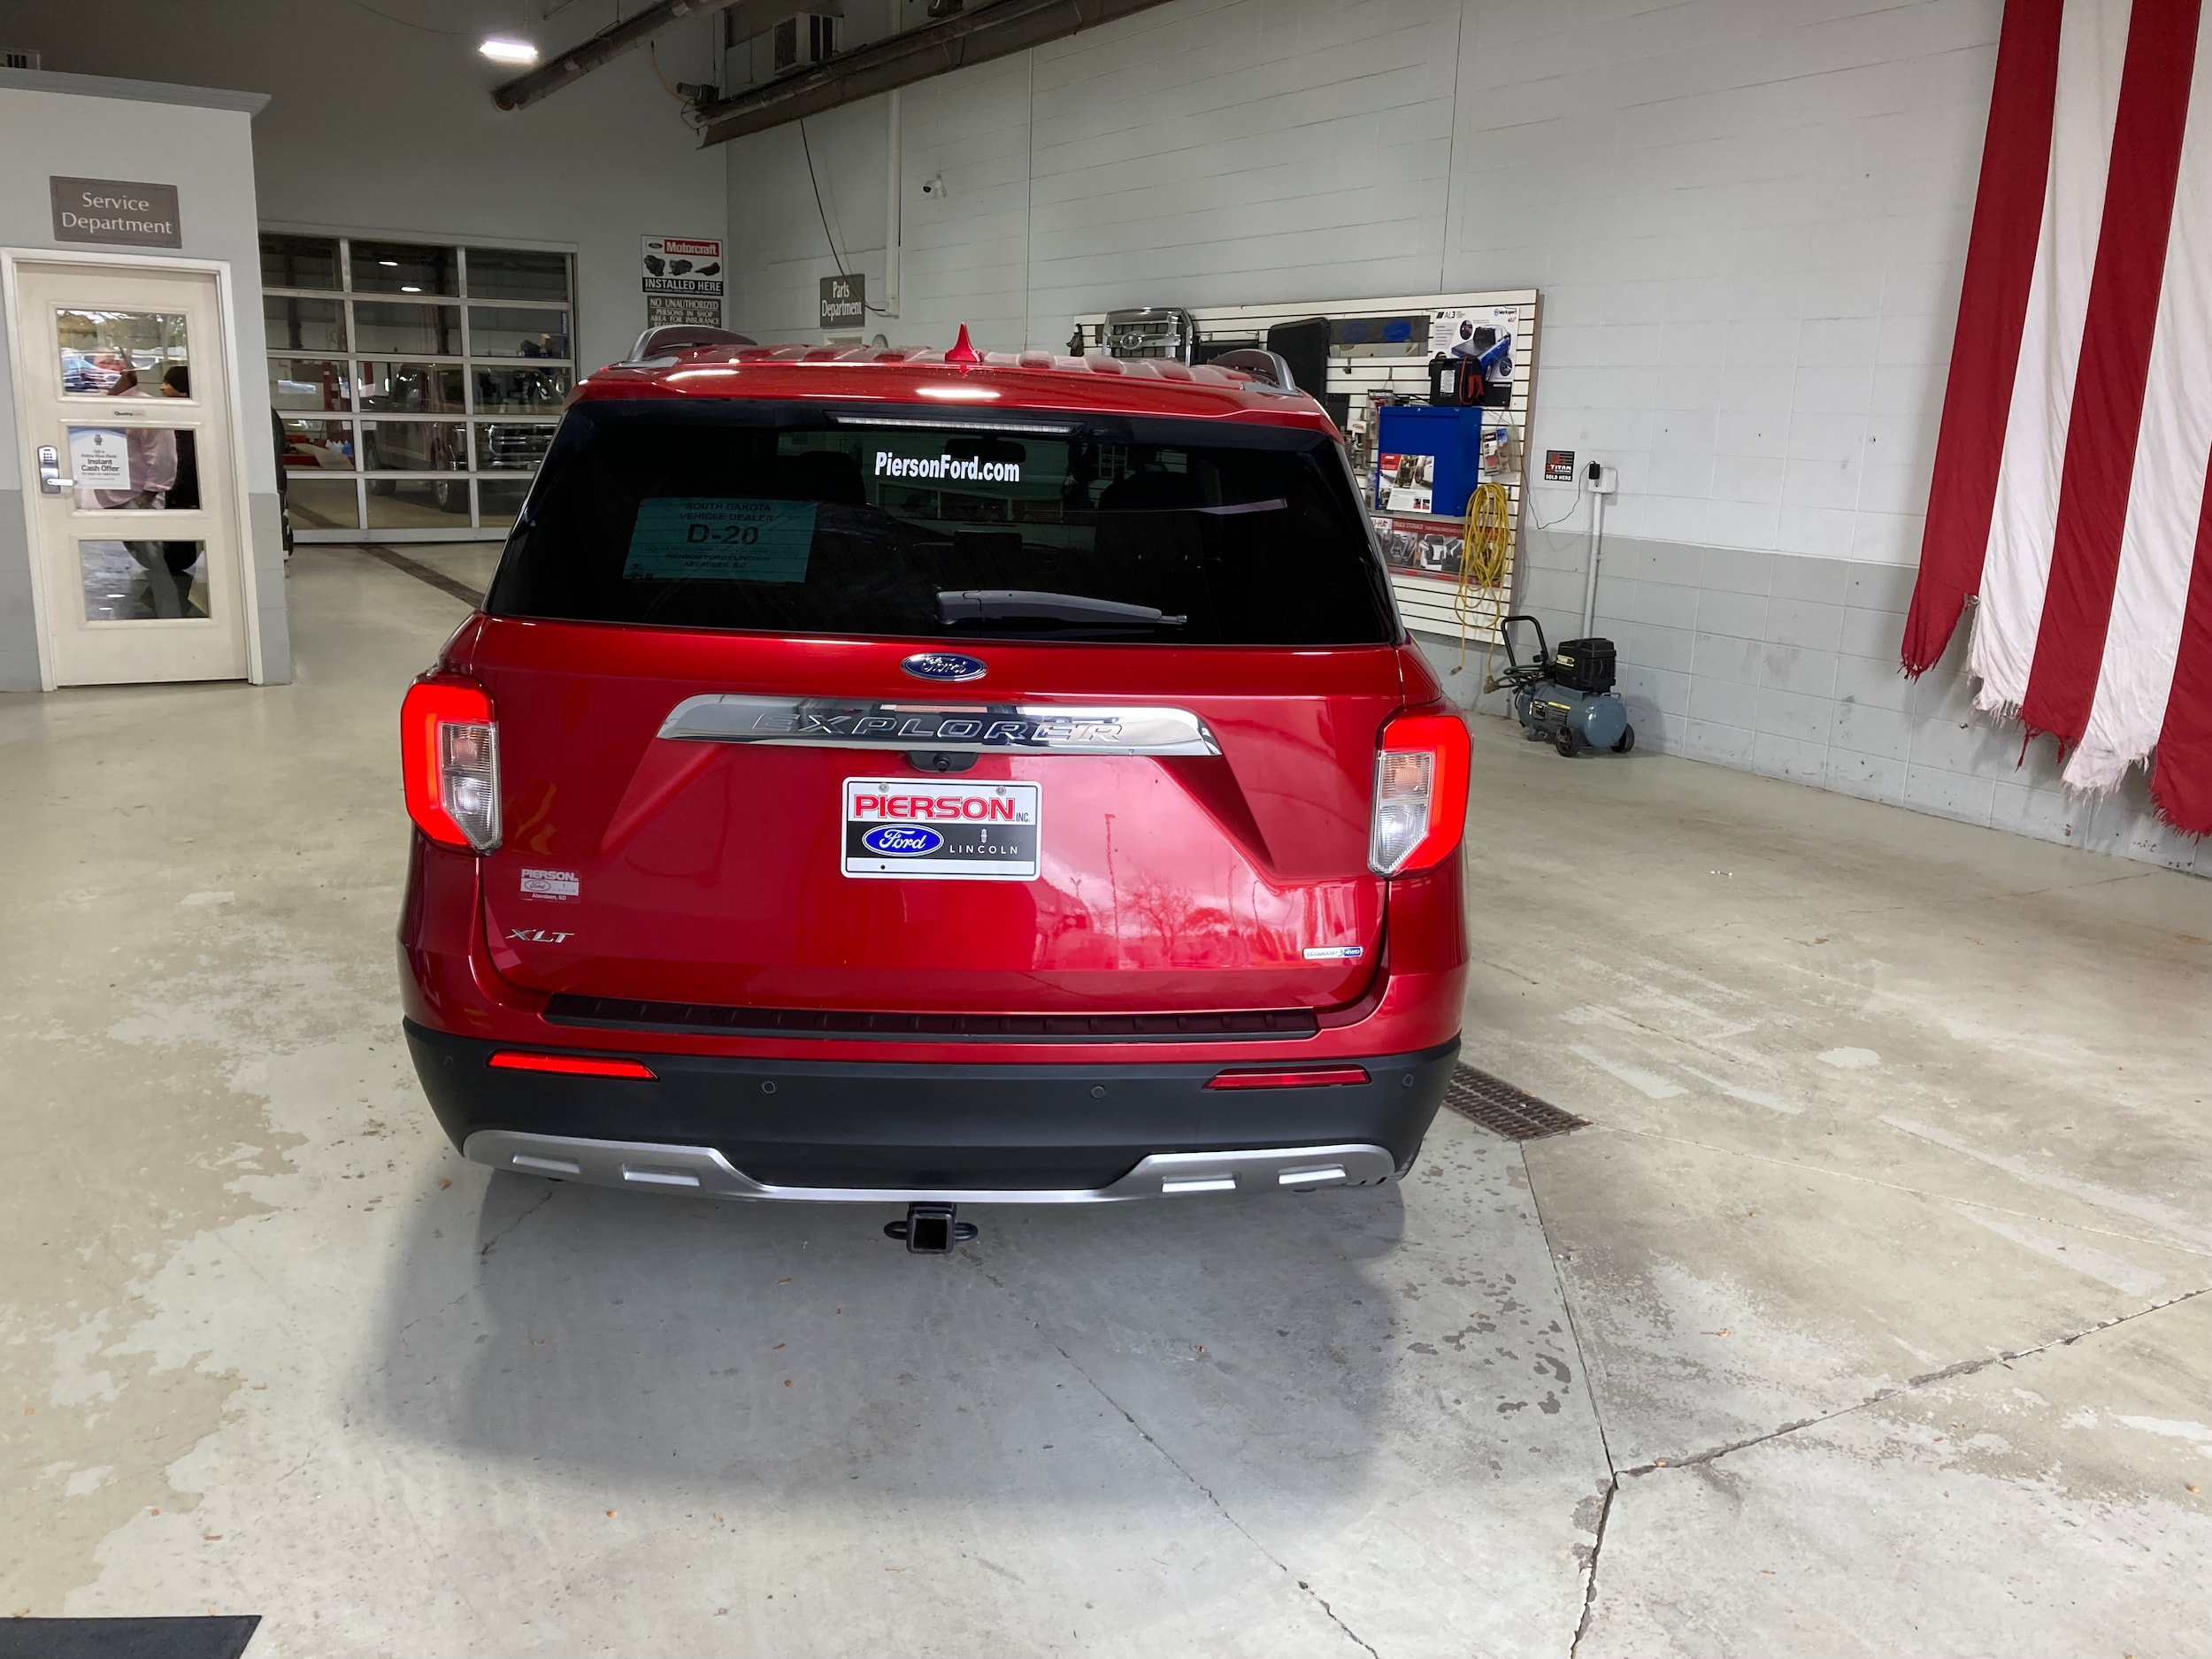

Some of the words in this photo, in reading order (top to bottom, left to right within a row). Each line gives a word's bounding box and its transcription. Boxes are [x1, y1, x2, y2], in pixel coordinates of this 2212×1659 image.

[82, 192, 150, 211] Service
[62, 212, 173, 234] Department
[666, 242, 718, 255] Motorcraft
[645, 278, 695, 290] INSTALLED
[697, 280, 722, 291] HERE
[833, 281, 849, 298] Parts
[650, 298, 662, 307] NO
[665, 299, 718, 310] UNAUTHORIZED
[822, 299, 862, 321] Department
[875, 451, 1019, 482] PiersonFord.com
[726, 503, 771, 511] DAKOTA
[687, 523, 759, 545] D-20
[922, 657, 967, 673] Ford
[752, 712, 1123, 742] EXPLORER
[854, 795, 1015, 822] PIERSON
[1016, 812, 1031, 823] INC.
[879, 828, 927, 850] Ford
[949, 844, 1018, 855] LINCOLN
[521, 869, 574, 881] PIERSON
[505, 927, 575, 943] XLT
